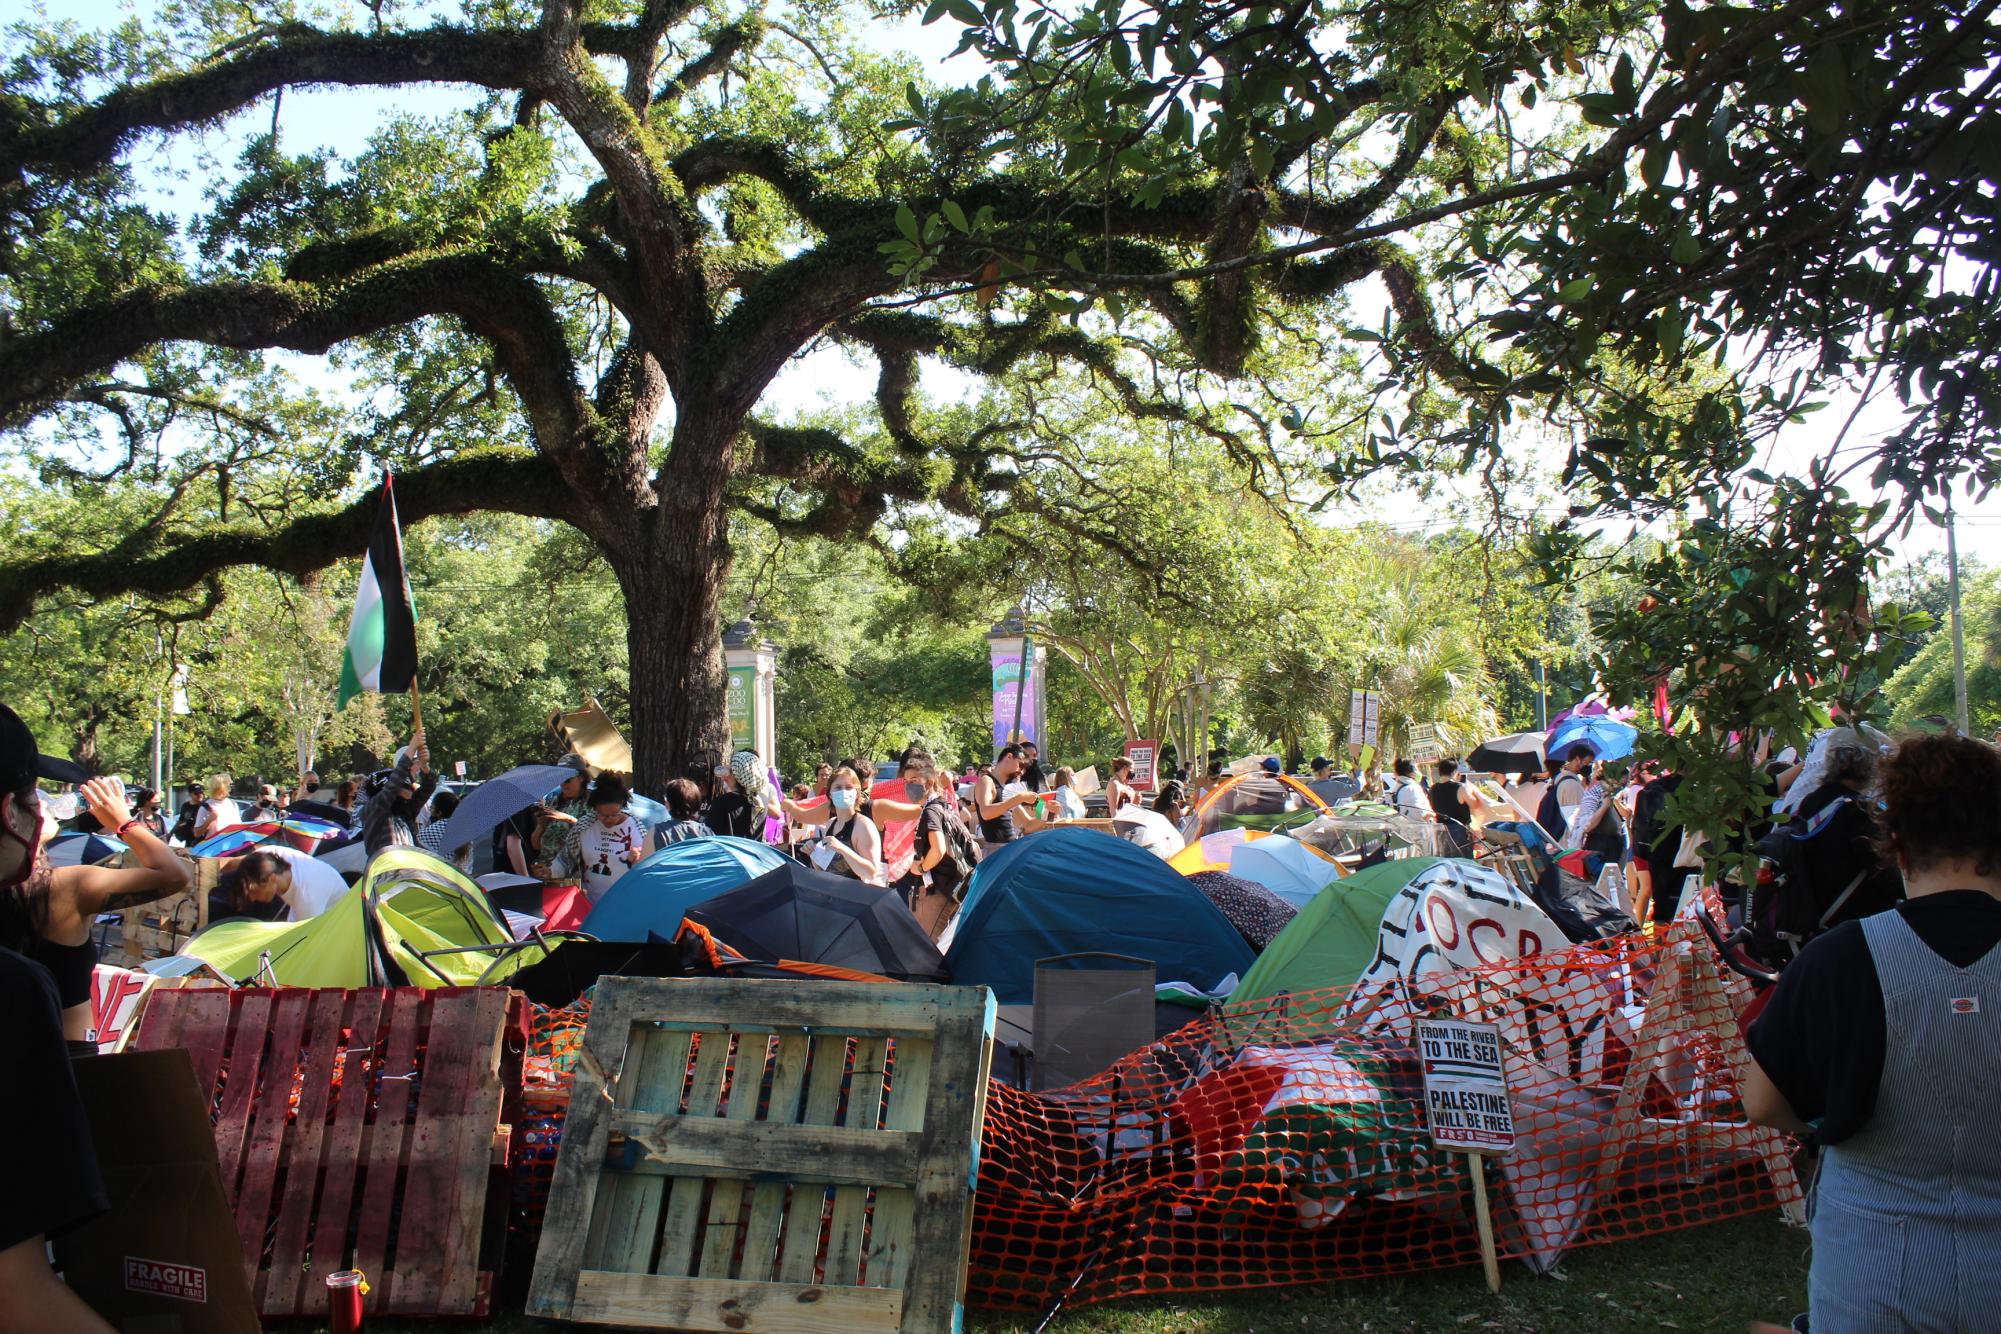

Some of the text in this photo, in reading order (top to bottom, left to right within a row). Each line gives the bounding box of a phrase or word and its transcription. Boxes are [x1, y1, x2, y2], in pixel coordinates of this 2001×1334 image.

[1420, 1026, 1497, 1045] FROM THE RIVER
[1423, 1040, 1499, 1064] TO THE SEA
[1430, 1090, 1508, 1115] PALESTINE
[1433, 1111, 1512, 1132] WILL BE FREE
[128, 1261, 203, 1289] FRAGILE
[162, 1284, 181, 1294] WITH
[183, 1287, 203, 1298] CARE
